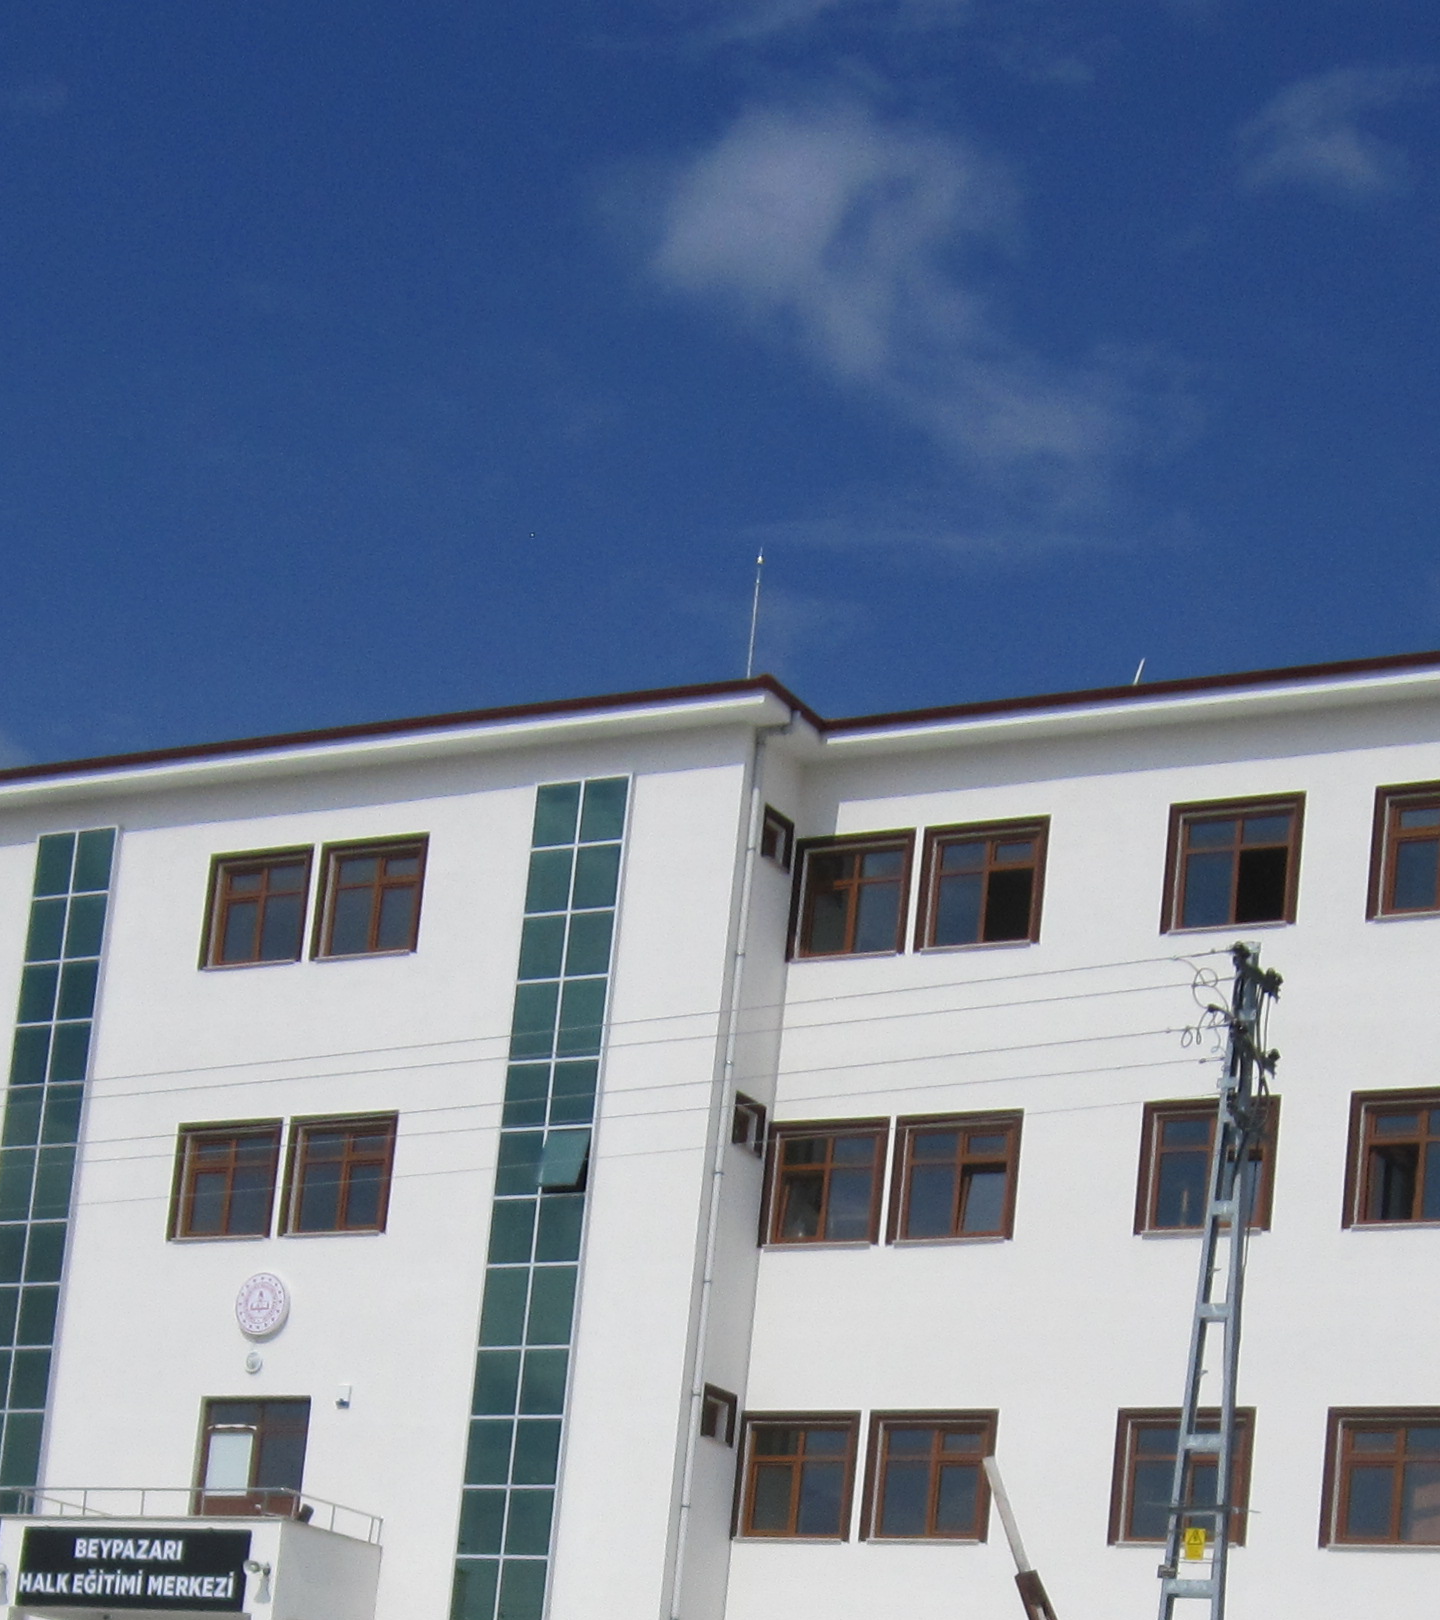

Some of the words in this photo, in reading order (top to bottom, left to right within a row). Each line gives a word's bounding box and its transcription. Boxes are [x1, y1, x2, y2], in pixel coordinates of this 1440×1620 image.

[74, 1538, 184, 1560] BEYPAZARI
[19, 1571, 70, 1594] HALK
[72, 1569, 144, 1596] EĞİTİMİ
[147, 1571, 235, 1598] MERKEZİ
